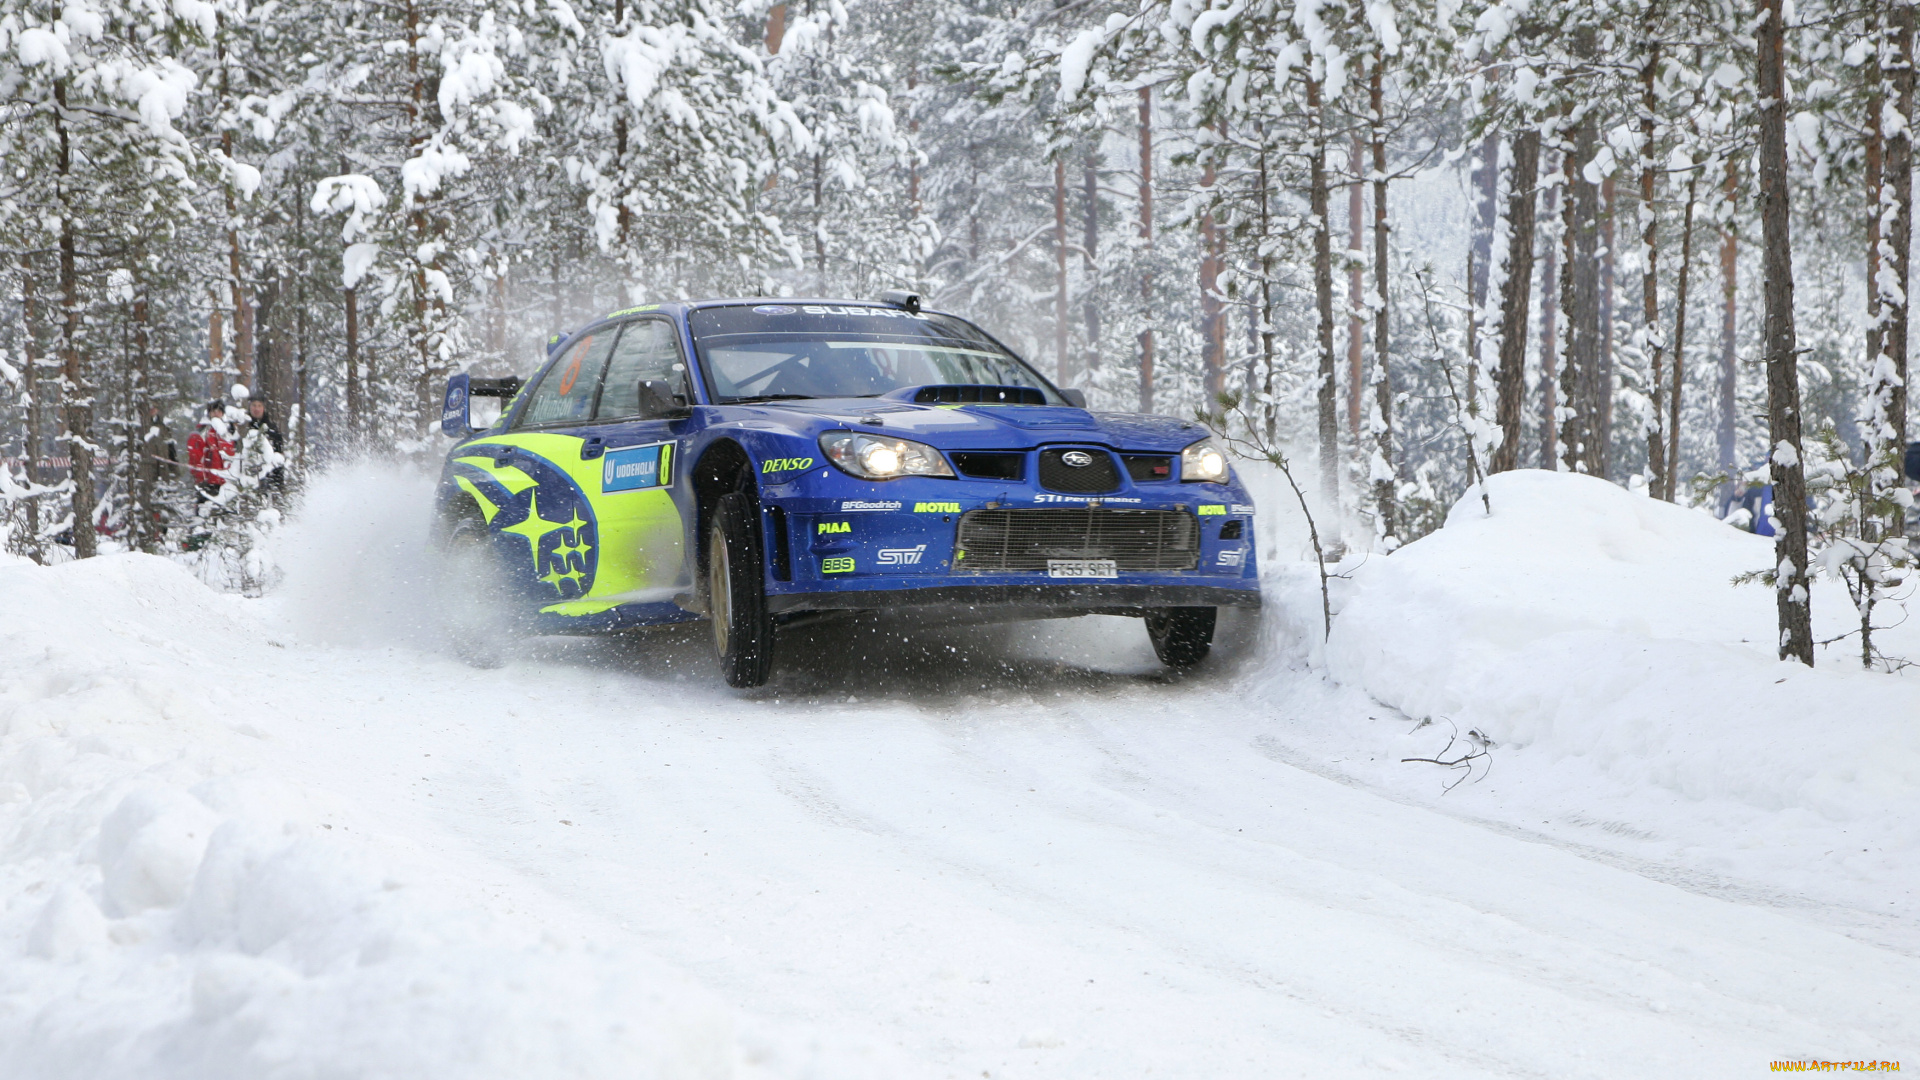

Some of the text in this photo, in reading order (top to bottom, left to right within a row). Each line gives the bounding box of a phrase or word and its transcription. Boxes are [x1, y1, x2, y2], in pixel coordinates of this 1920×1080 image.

[802, 305, 929, 320] SUBARU
[559, 335, 592, 396] 8
[616, 461, 655, 479] UDDEHOLM
[660, 444, 671, 485] 8
[762, 457, 813, 473] DENSO
[841, 501, 902, 509] BFGoodrich
[1033, 494, 1063, 503] STI
[913, 502, 961, 513] MOTUL
[818, 522, 852, 534] PIAA
[822, 558, 855, 573] BBS
